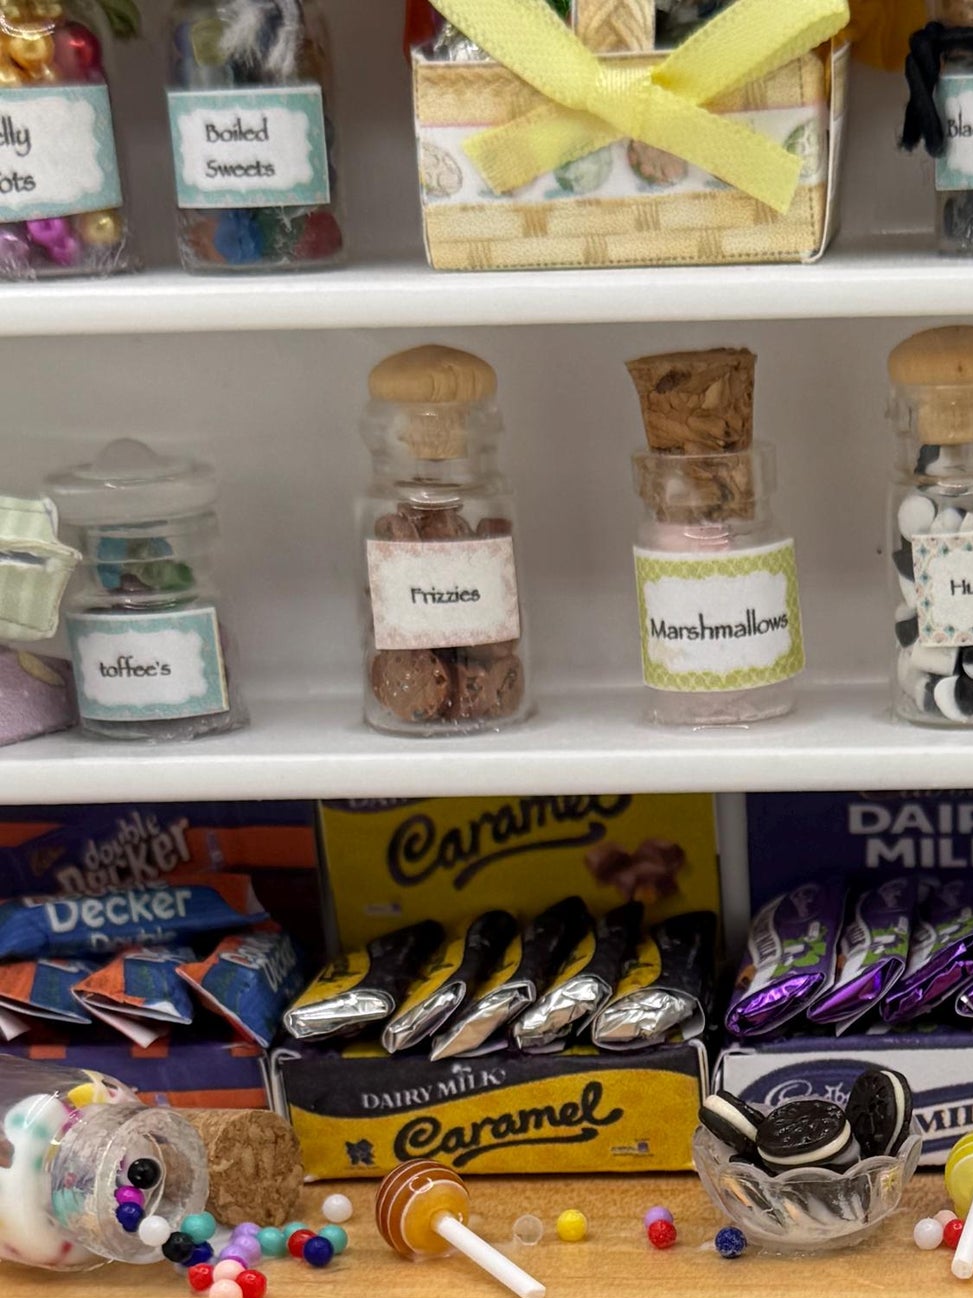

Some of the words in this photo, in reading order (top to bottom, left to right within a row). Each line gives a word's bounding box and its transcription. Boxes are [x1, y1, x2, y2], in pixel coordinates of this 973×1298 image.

[205, 119, 269, 143] Boiled
[205, 159, 276, 179] Sweets
[0, 171, 37, 194] ots
[411, 586, 481, 604] Frizzies
[650, 609, 789, 641] Marshmallows
[100, 654, 172, 680] toffee's
[45, 889, 192, 934] Decker
[361, 1083, 431, 1111] DAIRY
[437, 1068, 505, 1100] MILK
[393, 1081, 625, 1168] Caramel
